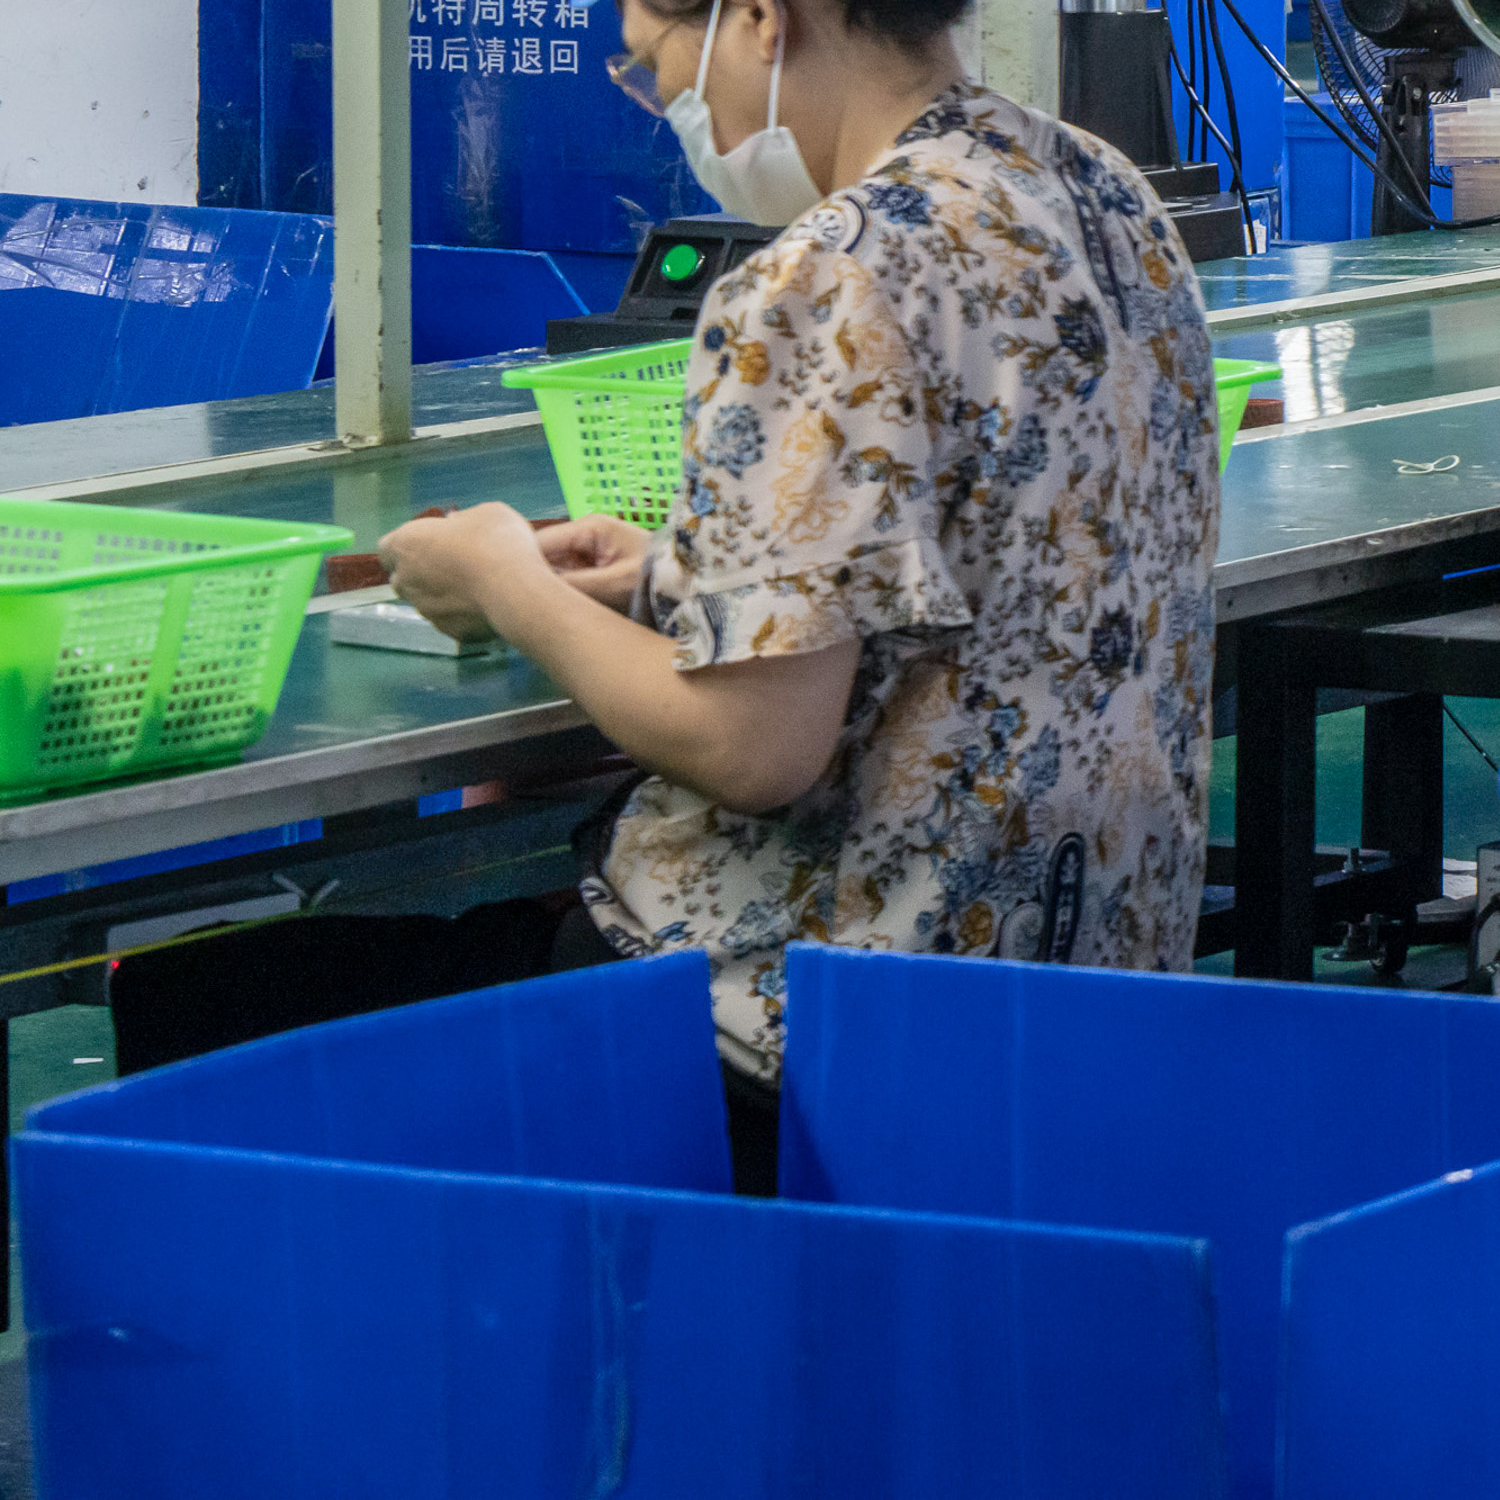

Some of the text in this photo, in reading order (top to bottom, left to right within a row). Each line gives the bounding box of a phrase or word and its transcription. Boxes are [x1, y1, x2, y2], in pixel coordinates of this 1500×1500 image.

[408, 35, 579, 75] 用后请退回
